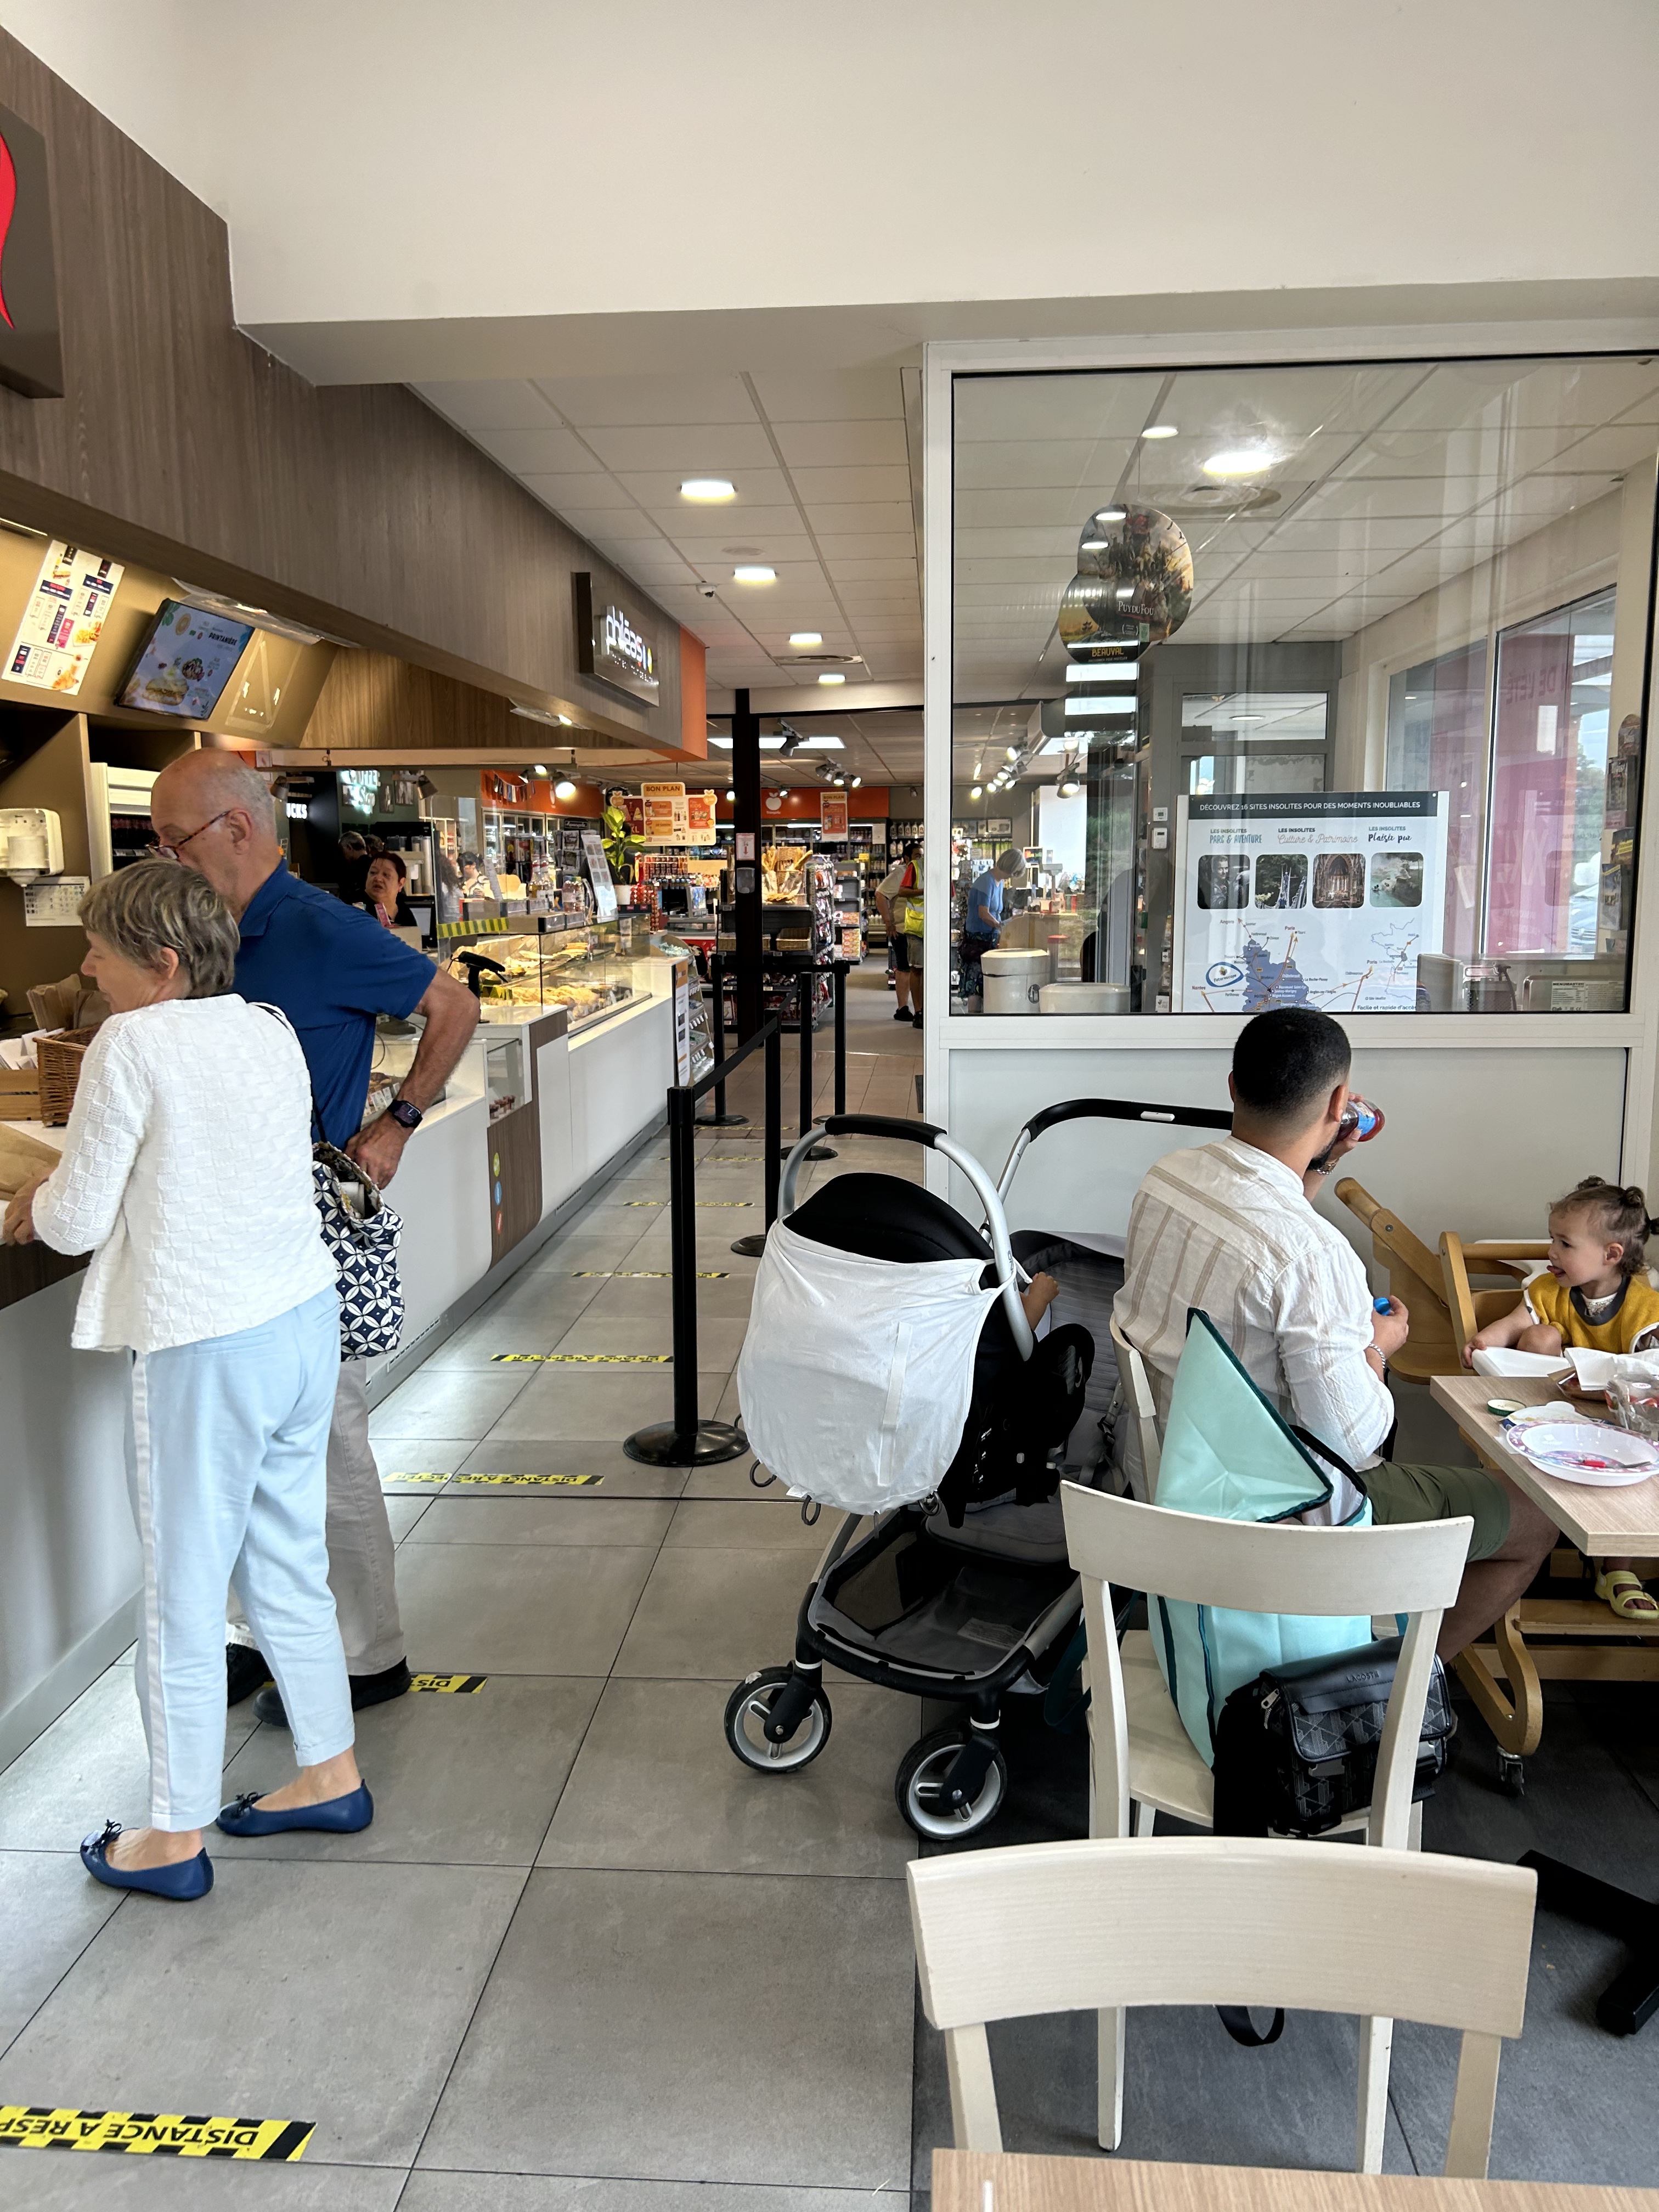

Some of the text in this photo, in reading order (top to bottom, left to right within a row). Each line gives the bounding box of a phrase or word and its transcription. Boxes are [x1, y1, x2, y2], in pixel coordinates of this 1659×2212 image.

[1092, 647, 1124, 657] BEAUVAL
[1210, 835, 1224, 844] PARC
[1234, 834, 1262, 844] AVENTURE
[1278, 834, 1306, 844] Culture
[1316, 833, 1358, 844] Patrimoine
[1368, 832, 1412, 844] Plaisir pur
[1346, 1671, 1380, 1683] LACOSTE
[80, 2122, 103, 2134] A
[103, 2123, 259, 2146] DISTANCE
